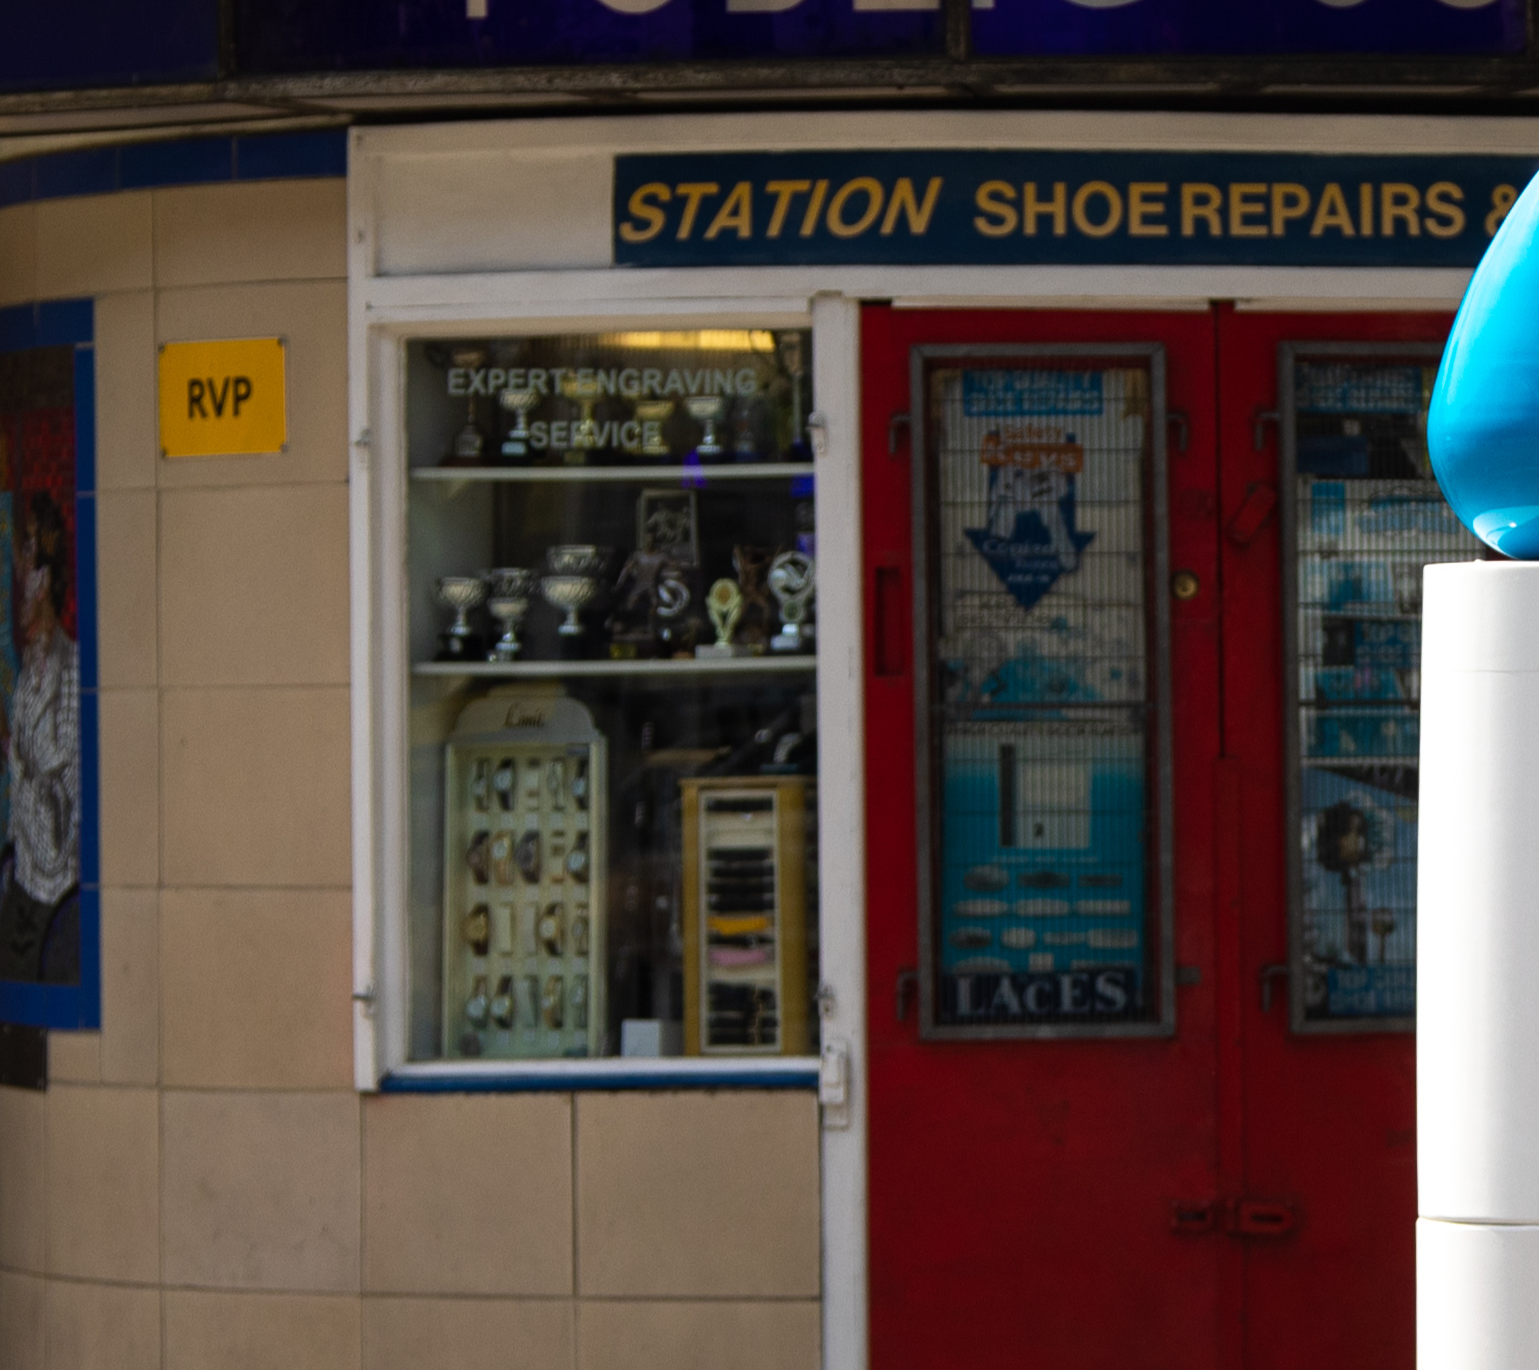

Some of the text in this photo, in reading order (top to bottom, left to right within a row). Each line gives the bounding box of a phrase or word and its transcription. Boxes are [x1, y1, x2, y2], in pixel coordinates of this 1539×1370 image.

[619, 176, 943, 244] STATION
[973, 179, 1170, 239] SHOE
[1182, 182, 1466, 240] REPAIRS
[187, 375, 253, 419] RVP
[447, 367, 758, 395] EXPERT ENGRAVING
[529, 420, 660, 449] SERVICE
